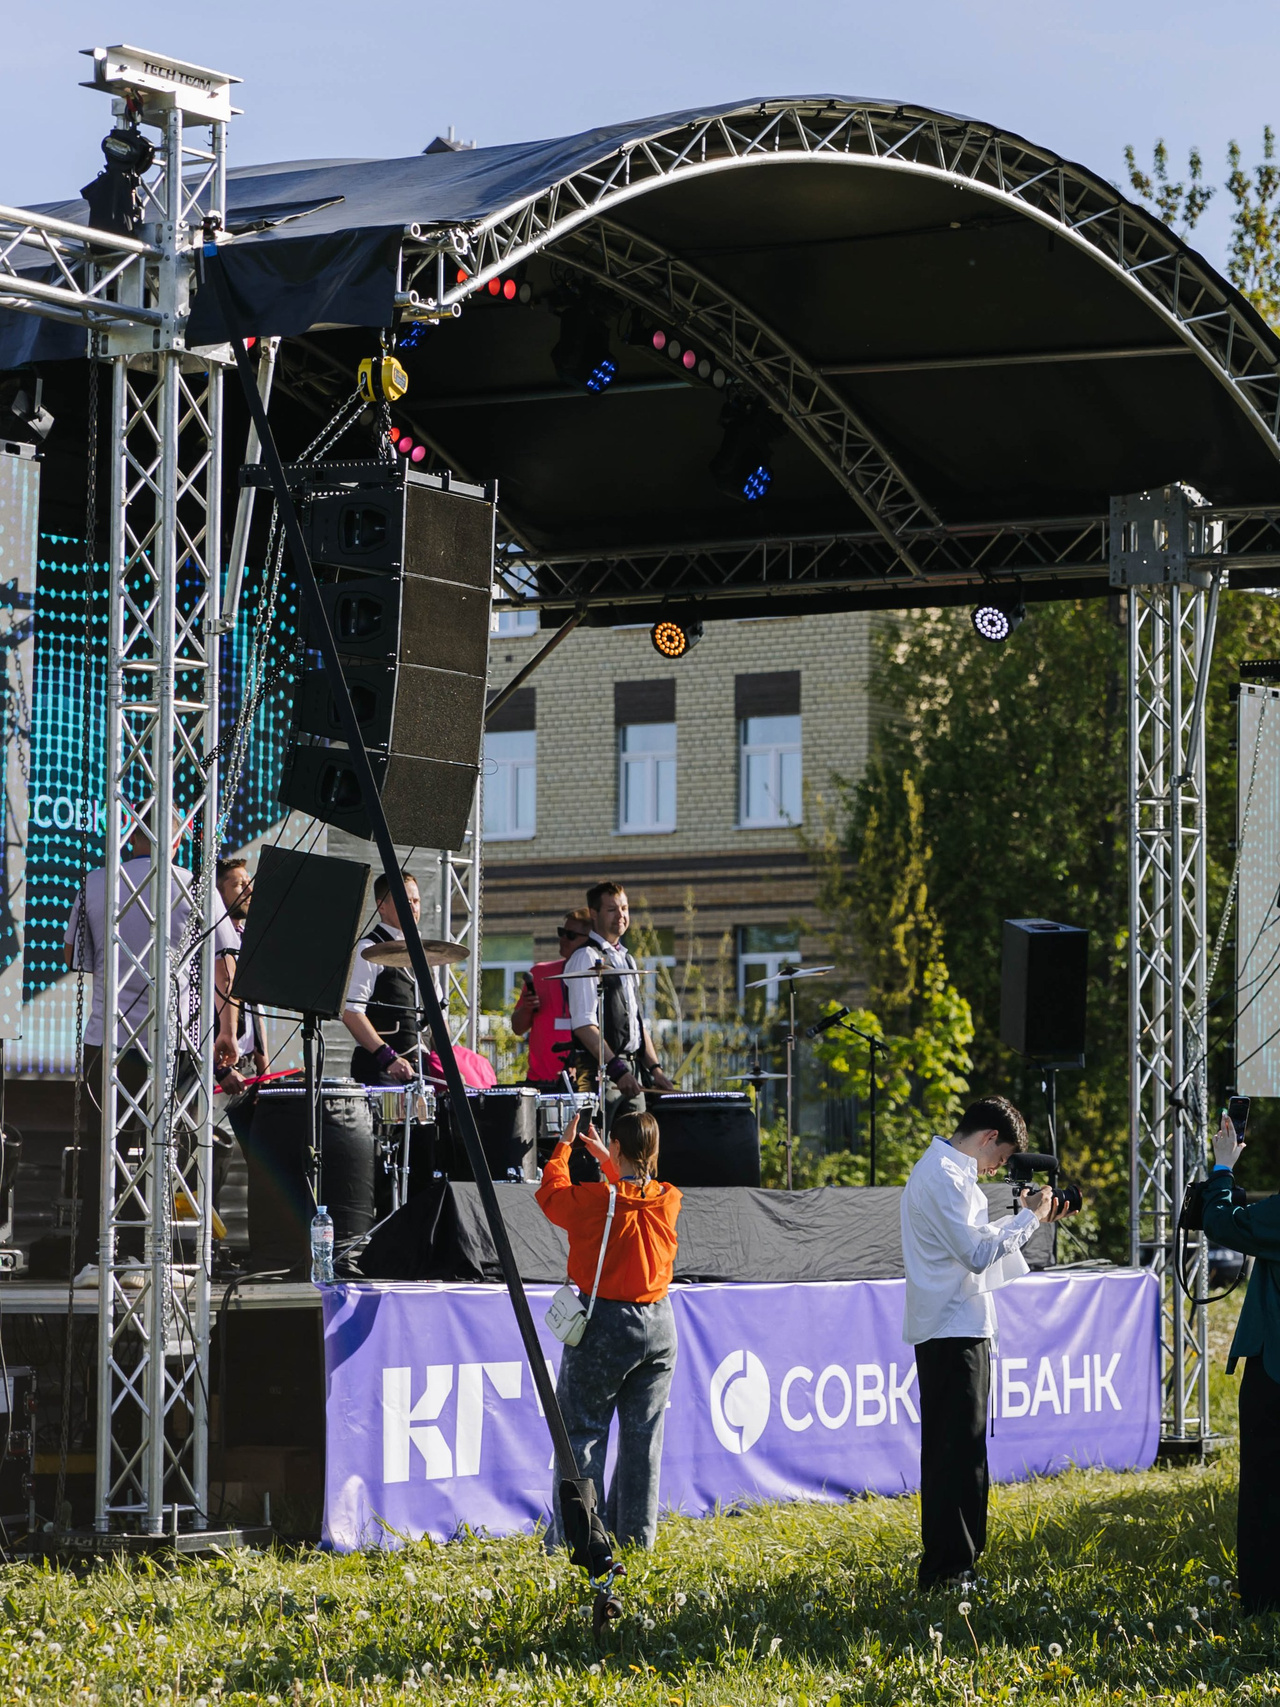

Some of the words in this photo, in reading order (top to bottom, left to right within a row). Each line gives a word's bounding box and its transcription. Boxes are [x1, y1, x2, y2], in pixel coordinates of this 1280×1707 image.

[143, 61, 176, 81] TECH
[179, 72, 211, 91] TEAM
[779, 1353, 1123, 1432] СОВКБАНК
